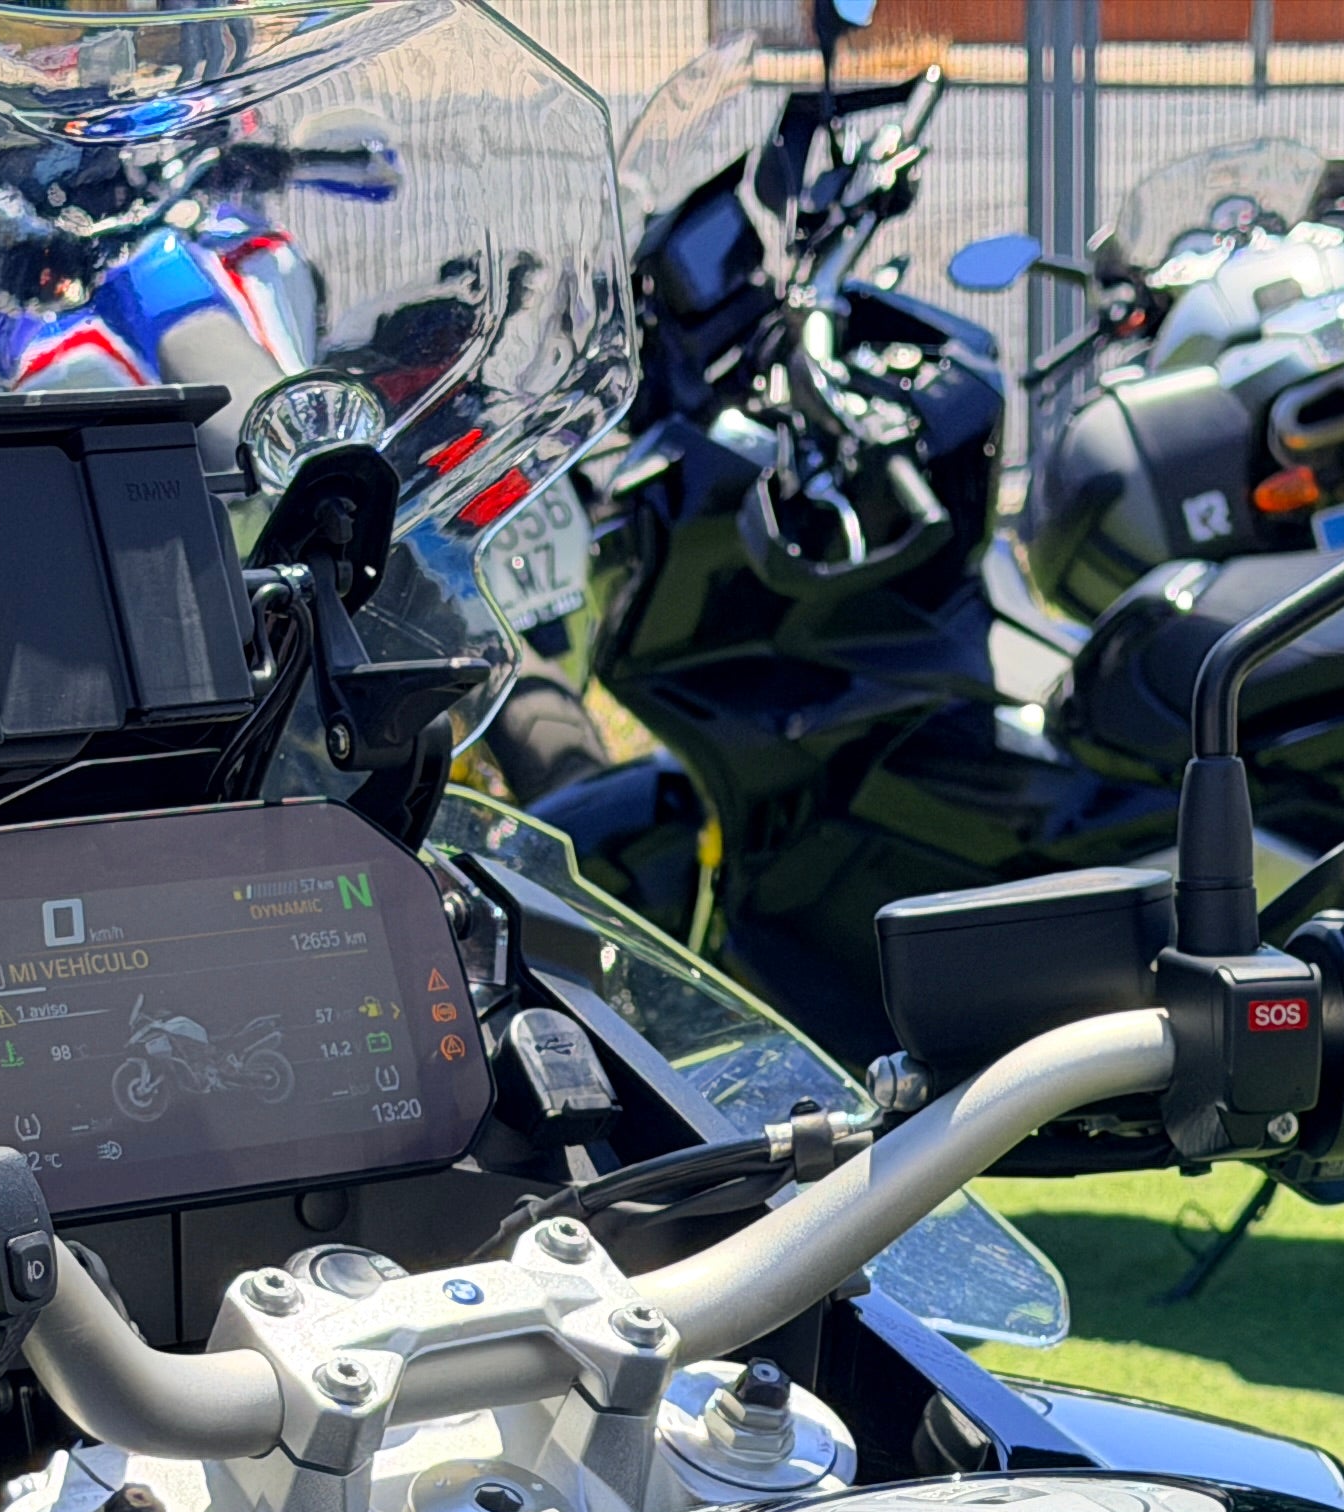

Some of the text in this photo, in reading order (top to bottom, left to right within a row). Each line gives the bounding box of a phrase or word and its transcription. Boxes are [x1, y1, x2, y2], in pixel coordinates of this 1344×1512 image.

[337, 873, 373, 910] N
[249, 899, 323, 919] DYNAMIC
[42, 898, 85, 947] 0
[290, 929, 367, 951] 12655 km
[9, 949, 149, 984] MI VEHÍCULO
[16, 1003, 68, 1019] 1 aviso
[316, 1007, 333, 1023] 57
[1254, 1003, 1301, 1027] SOS
[51, 1044, 72, 1061] 98
[320, 1041, 353, 1058] 14.2
[372, 1098, 422, 1123] 13:20
